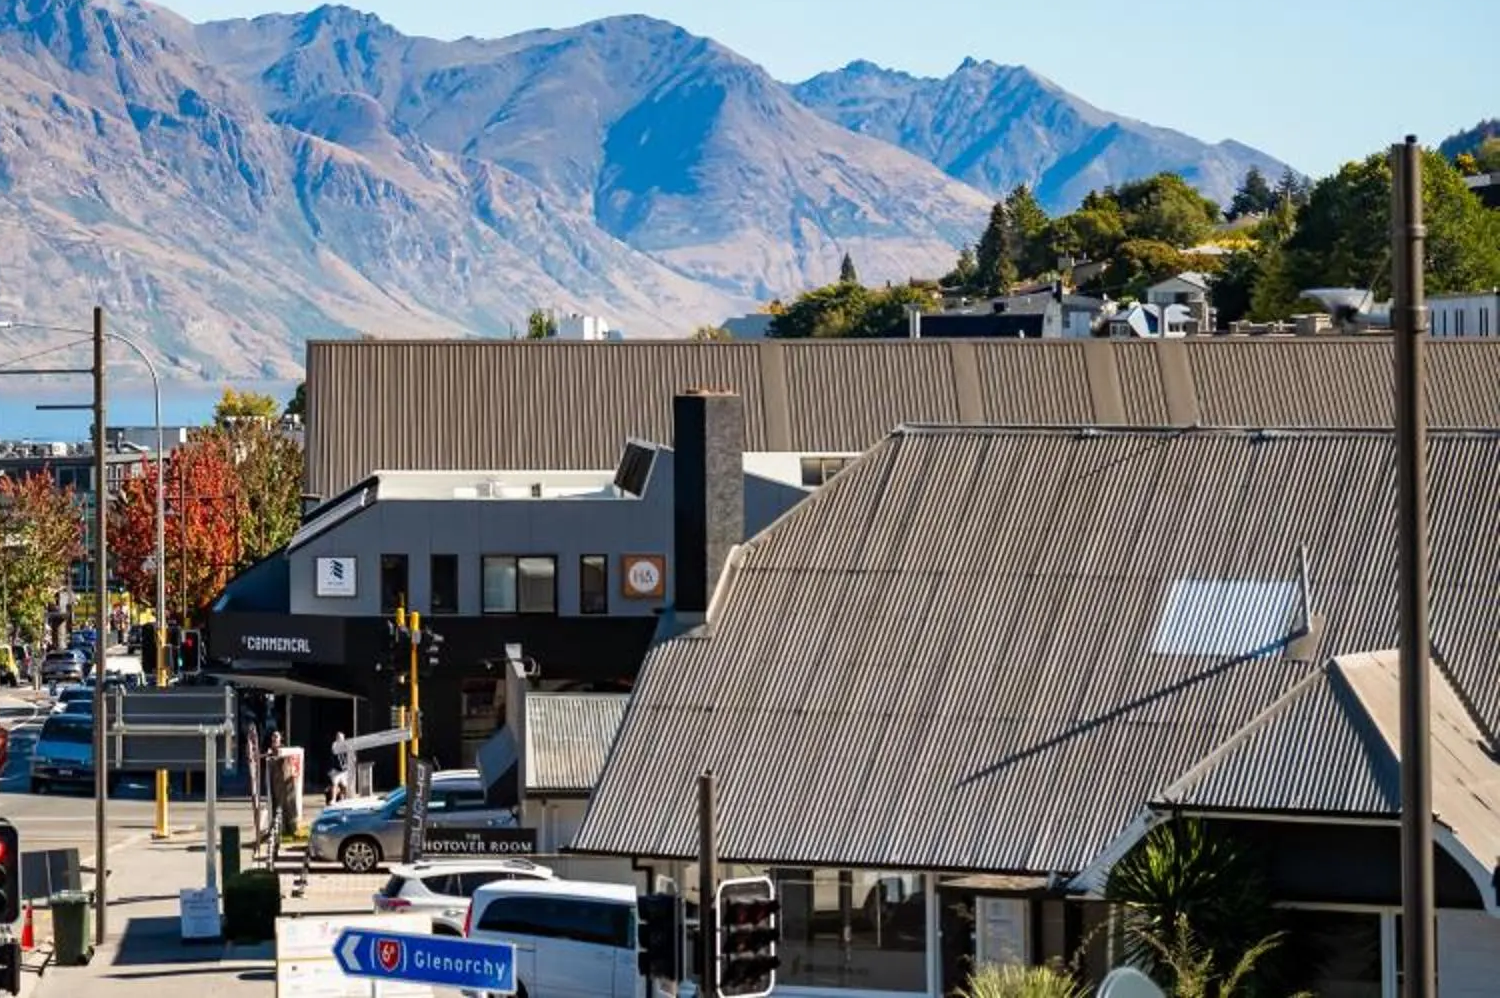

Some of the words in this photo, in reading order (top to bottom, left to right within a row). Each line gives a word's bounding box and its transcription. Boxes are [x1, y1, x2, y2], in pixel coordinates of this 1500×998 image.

[422, 841, 486, 853] HOTOVER
[490, 841, 533, 854] ROOM
[414, 951, 506, 981] Glenorchy
